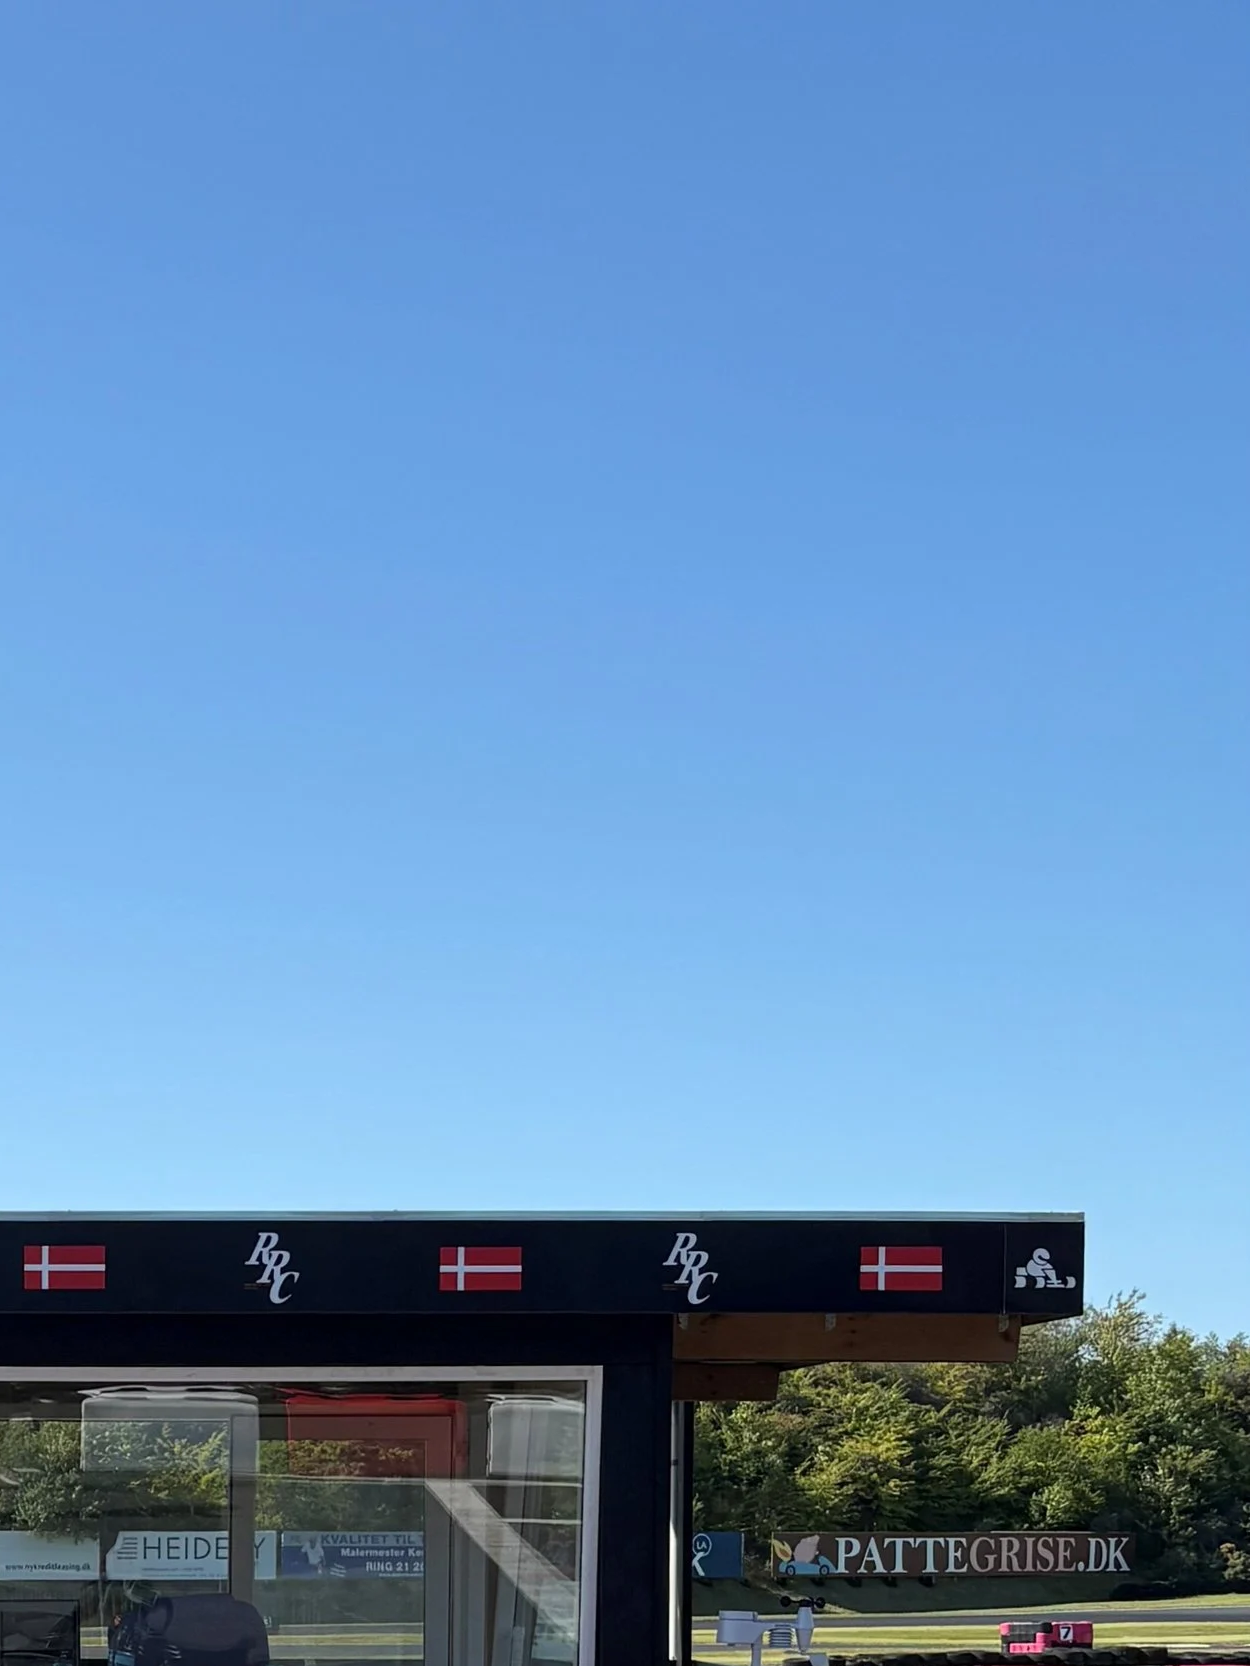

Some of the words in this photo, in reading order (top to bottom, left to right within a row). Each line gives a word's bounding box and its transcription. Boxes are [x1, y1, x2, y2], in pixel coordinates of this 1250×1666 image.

[244, 1232, 300, 1304] RRC
[662, 1233, 718, 1304] RRC
[321, 1534, 391, 1545] KVALITET
[395, 1534, 415, 1545] TIL
[835, 1536, 1131, 1574] PATTEGRISE.DK
[1060, 1626, 1072, 1640] 7
